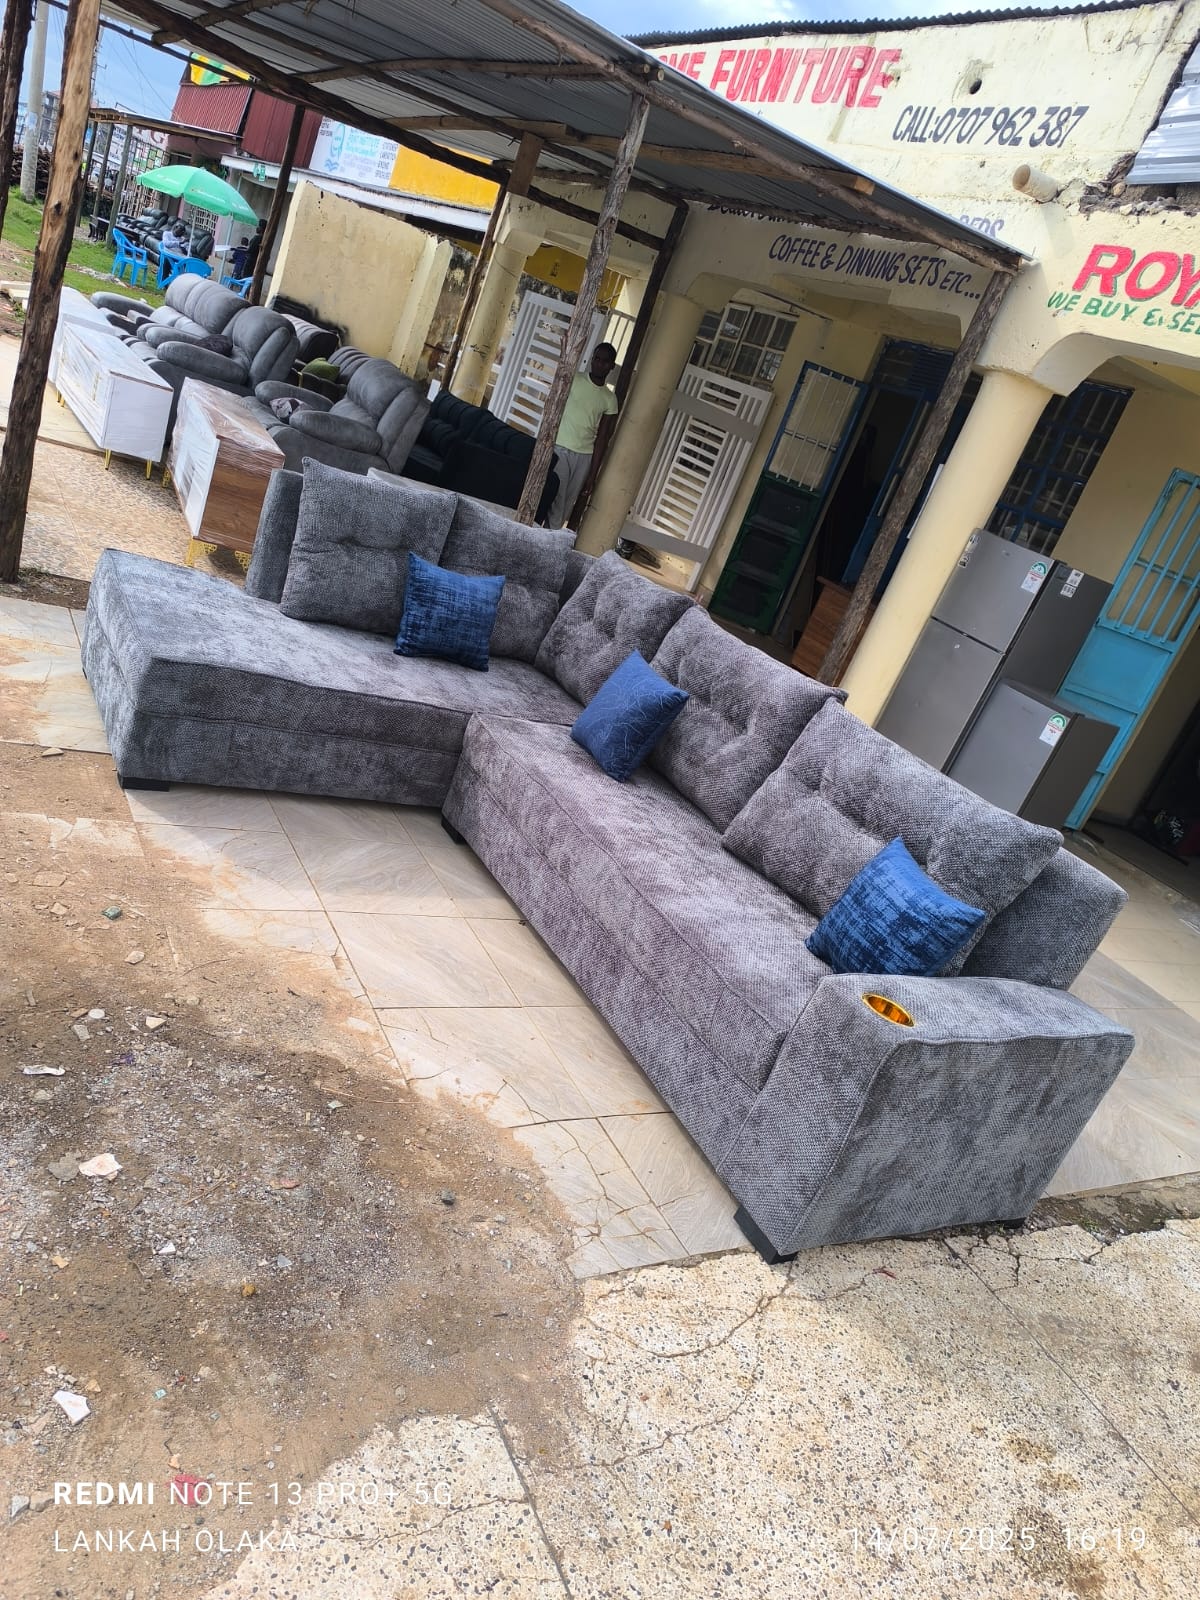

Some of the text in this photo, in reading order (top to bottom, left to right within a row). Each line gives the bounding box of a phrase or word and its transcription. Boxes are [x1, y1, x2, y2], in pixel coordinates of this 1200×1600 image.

[710, 46, 902, 108] FURNITURE
[984, 107, 1036, 146] 962
[1029, 106, 1089, 148] 387
[769, 234, 826, 268] COFFEE
[820, 243, 838, 270] &
[835, 245, 905, 282] DINNING
[898, 254, 946, 287] SETS
[1072, 244, 1200, 310] ROY
[1047, 291, 1082, 312] WE
[1081, 297, 1140, 322] BUY
